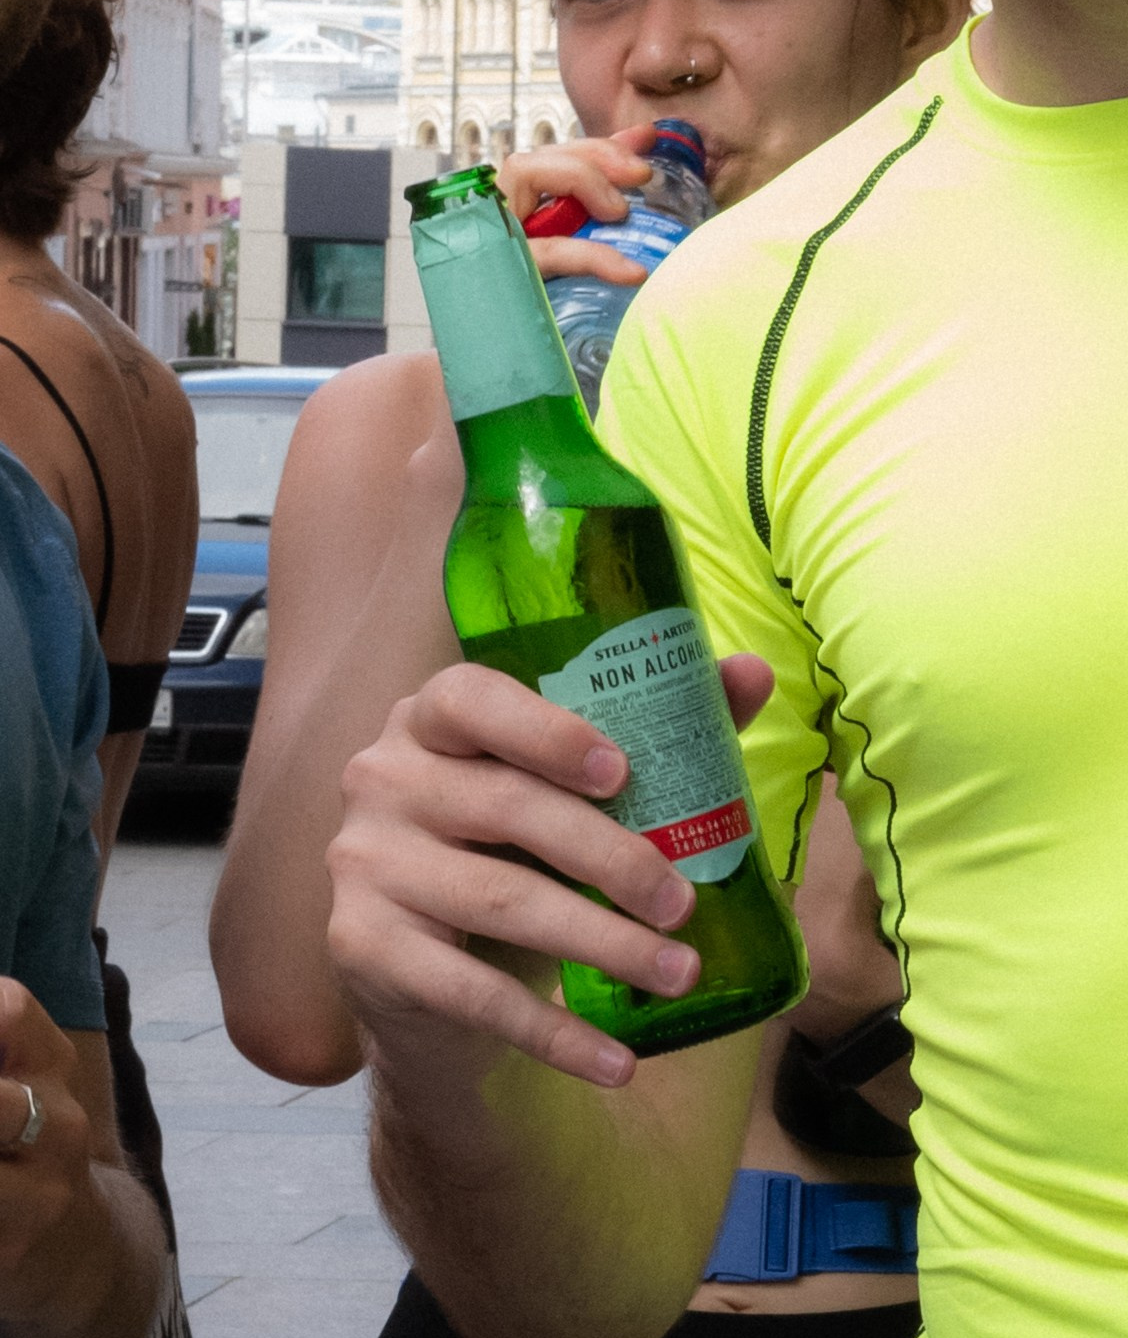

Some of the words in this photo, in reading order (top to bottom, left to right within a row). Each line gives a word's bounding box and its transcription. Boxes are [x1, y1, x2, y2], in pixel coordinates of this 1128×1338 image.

[594, 636, 648, 662] STELLA
[662, 618, 697, 641] ARTOIS
[589, 663, 636, 694] NON
